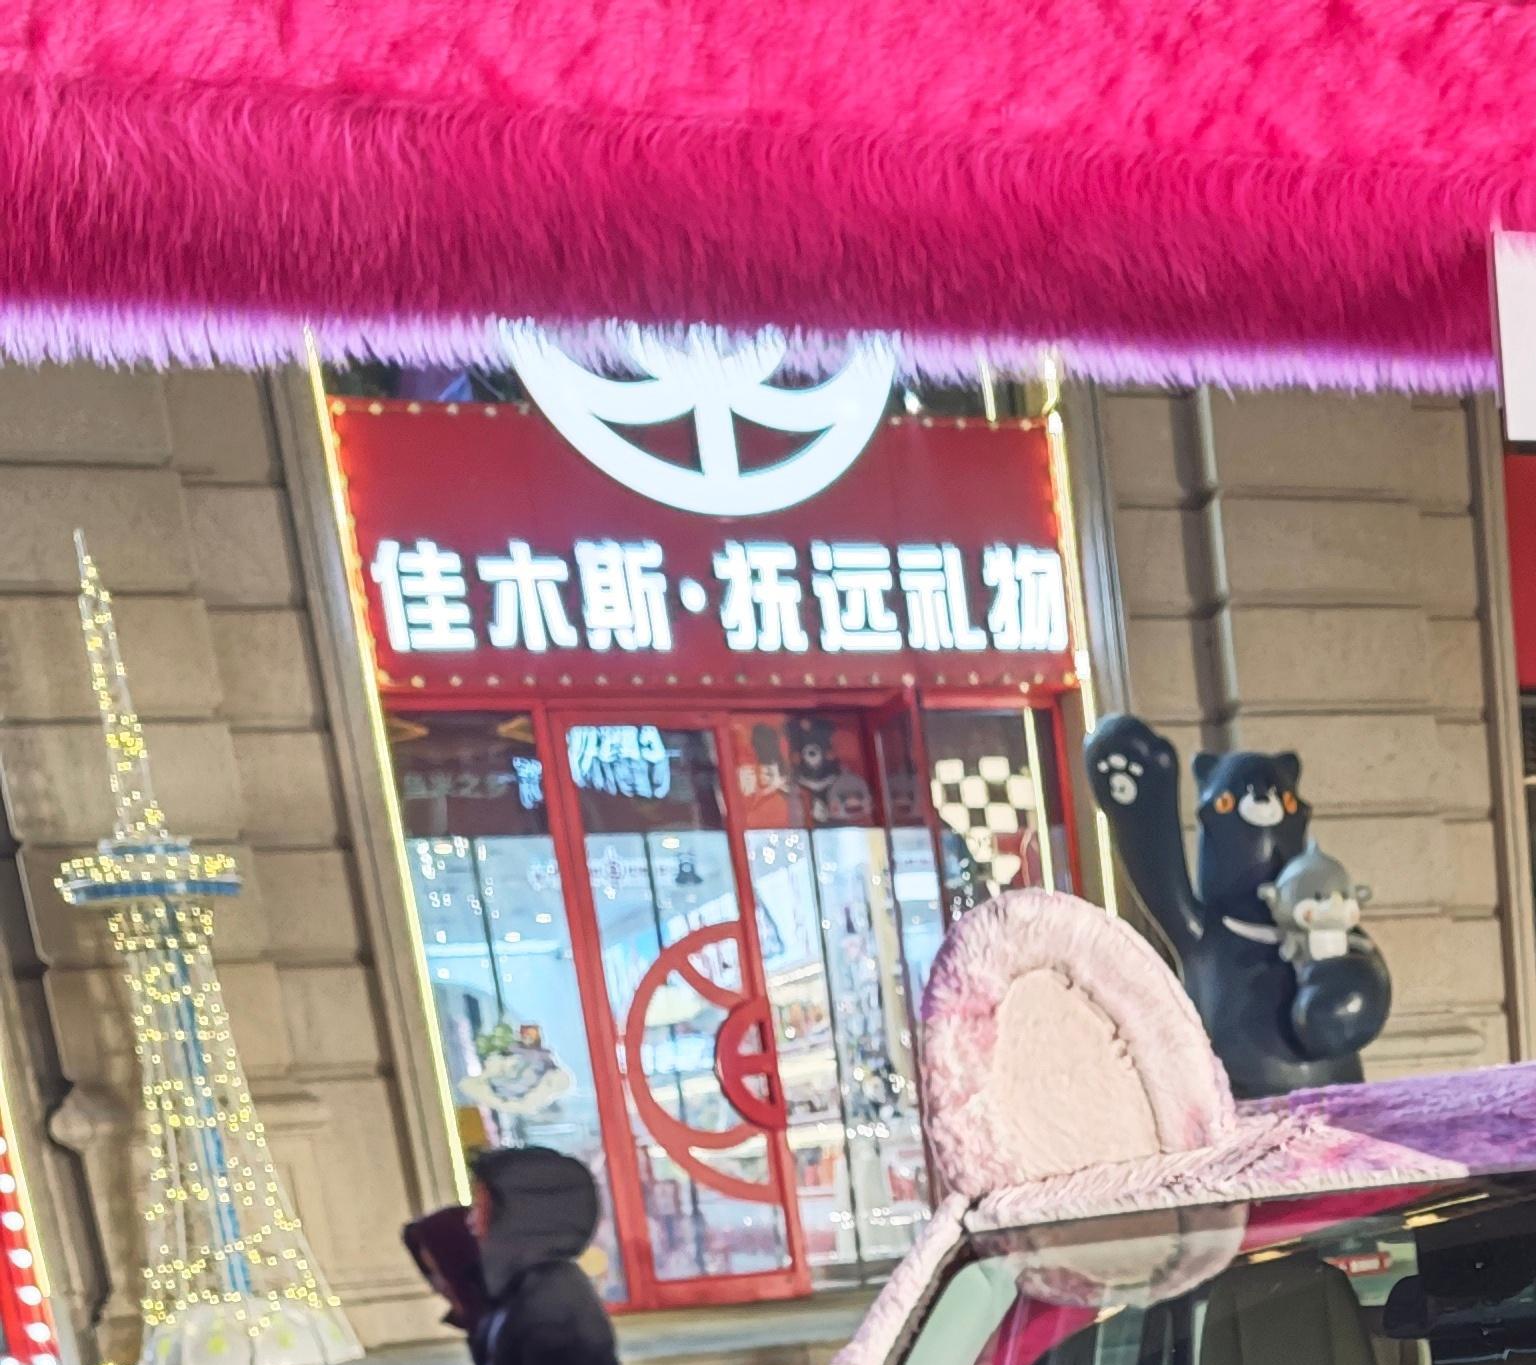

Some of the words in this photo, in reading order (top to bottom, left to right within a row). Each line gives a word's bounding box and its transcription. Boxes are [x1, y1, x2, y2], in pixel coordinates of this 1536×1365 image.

[371, 538, 1070, 653] 佳木斯·抚远礼物
